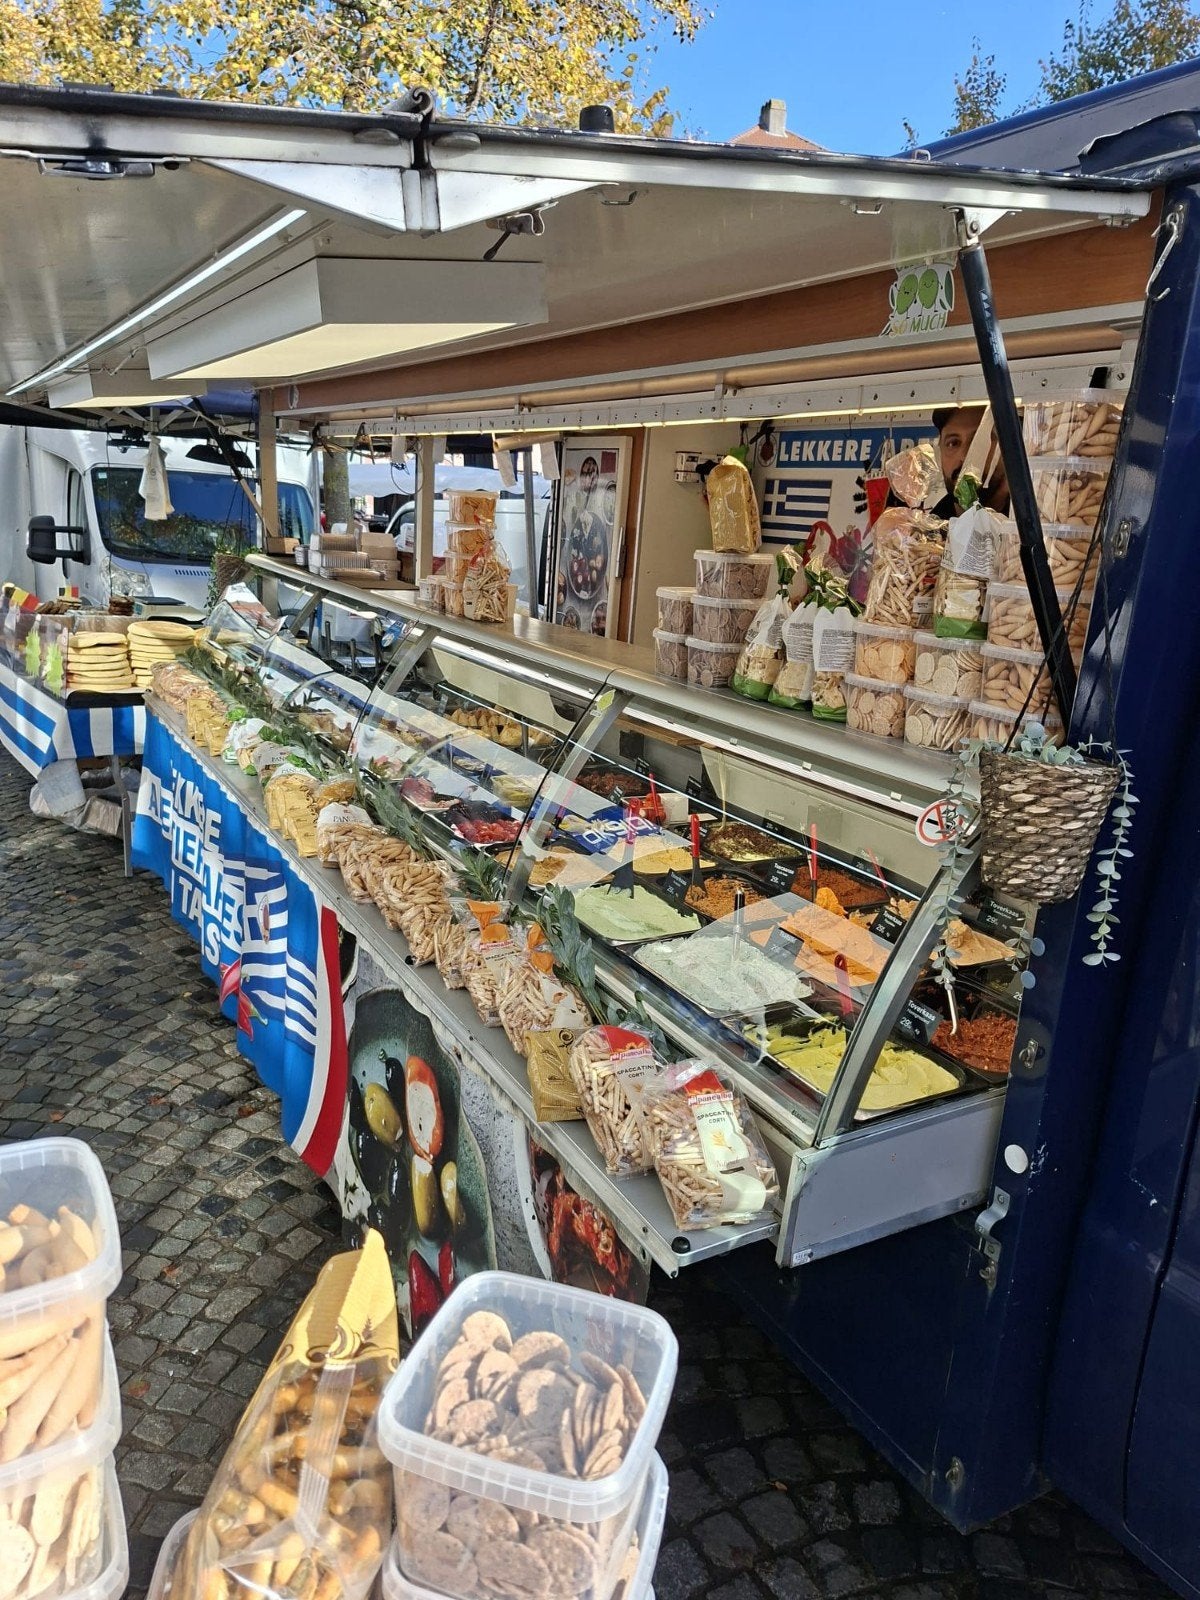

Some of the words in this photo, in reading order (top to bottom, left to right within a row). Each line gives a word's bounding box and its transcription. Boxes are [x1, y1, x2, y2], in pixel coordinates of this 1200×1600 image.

[909, 313, 947, 332] MUCH
[779, 439, 872, 462] LEKKERE
[990, 900, 1019, 917] Toverkaas
[908, 1000, 936, 1021] Toverkaas
